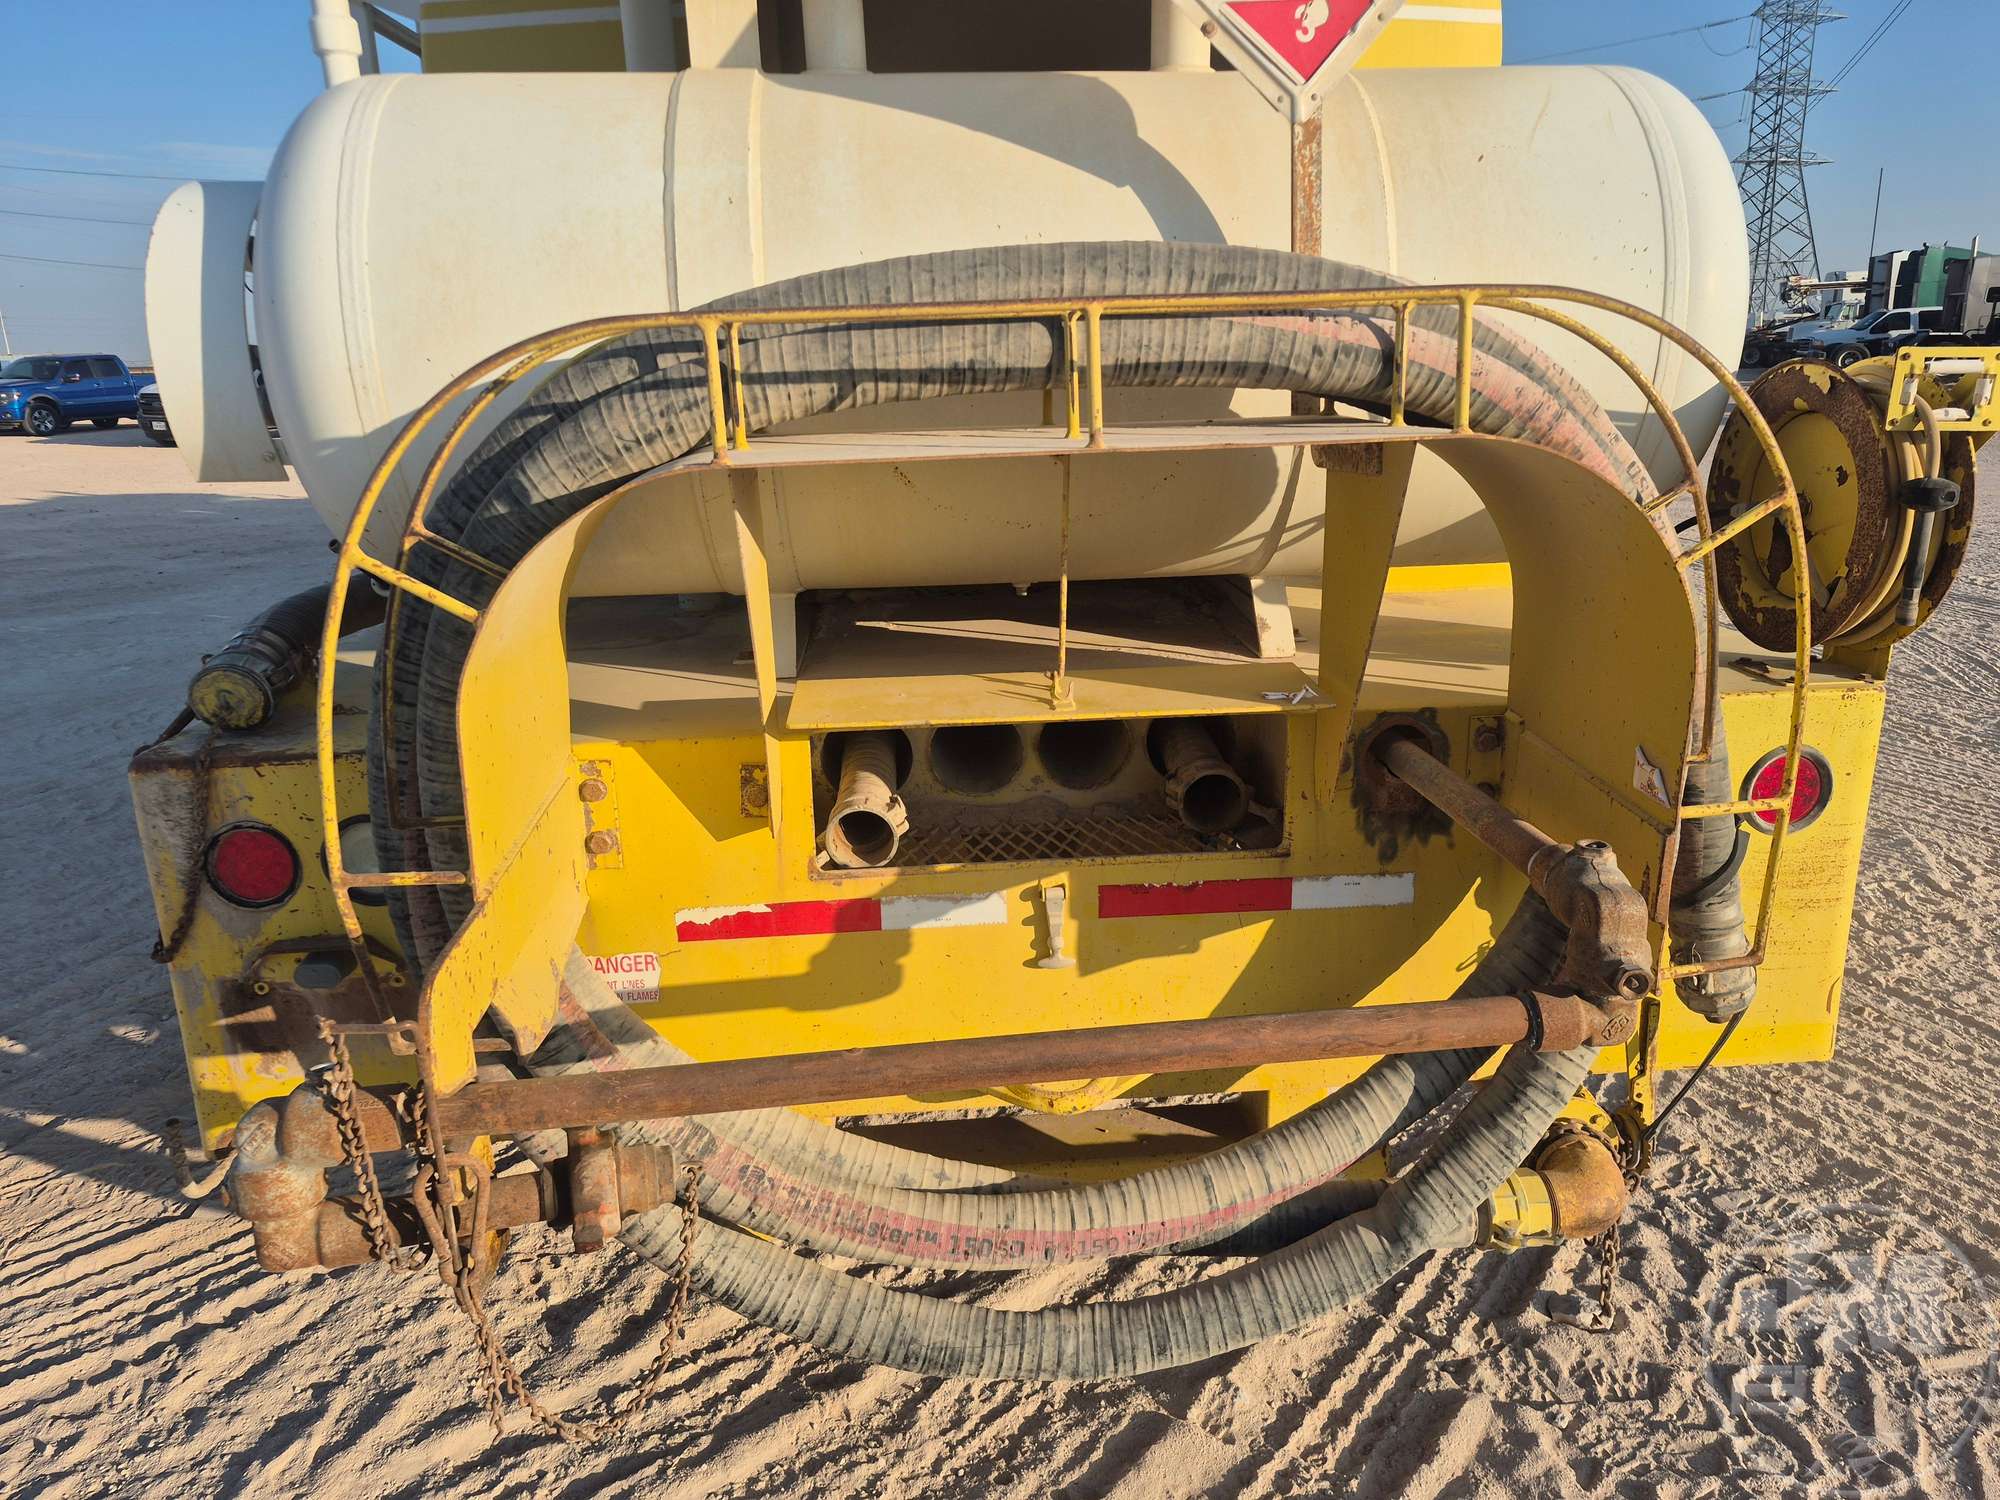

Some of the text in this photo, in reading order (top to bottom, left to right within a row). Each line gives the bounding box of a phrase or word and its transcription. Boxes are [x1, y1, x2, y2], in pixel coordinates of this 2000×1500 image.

[1294, 2, 1317, 43] 3
[587, 954, 656, 974] ANGER
[627, 989, 659, 1001] FLAMES
